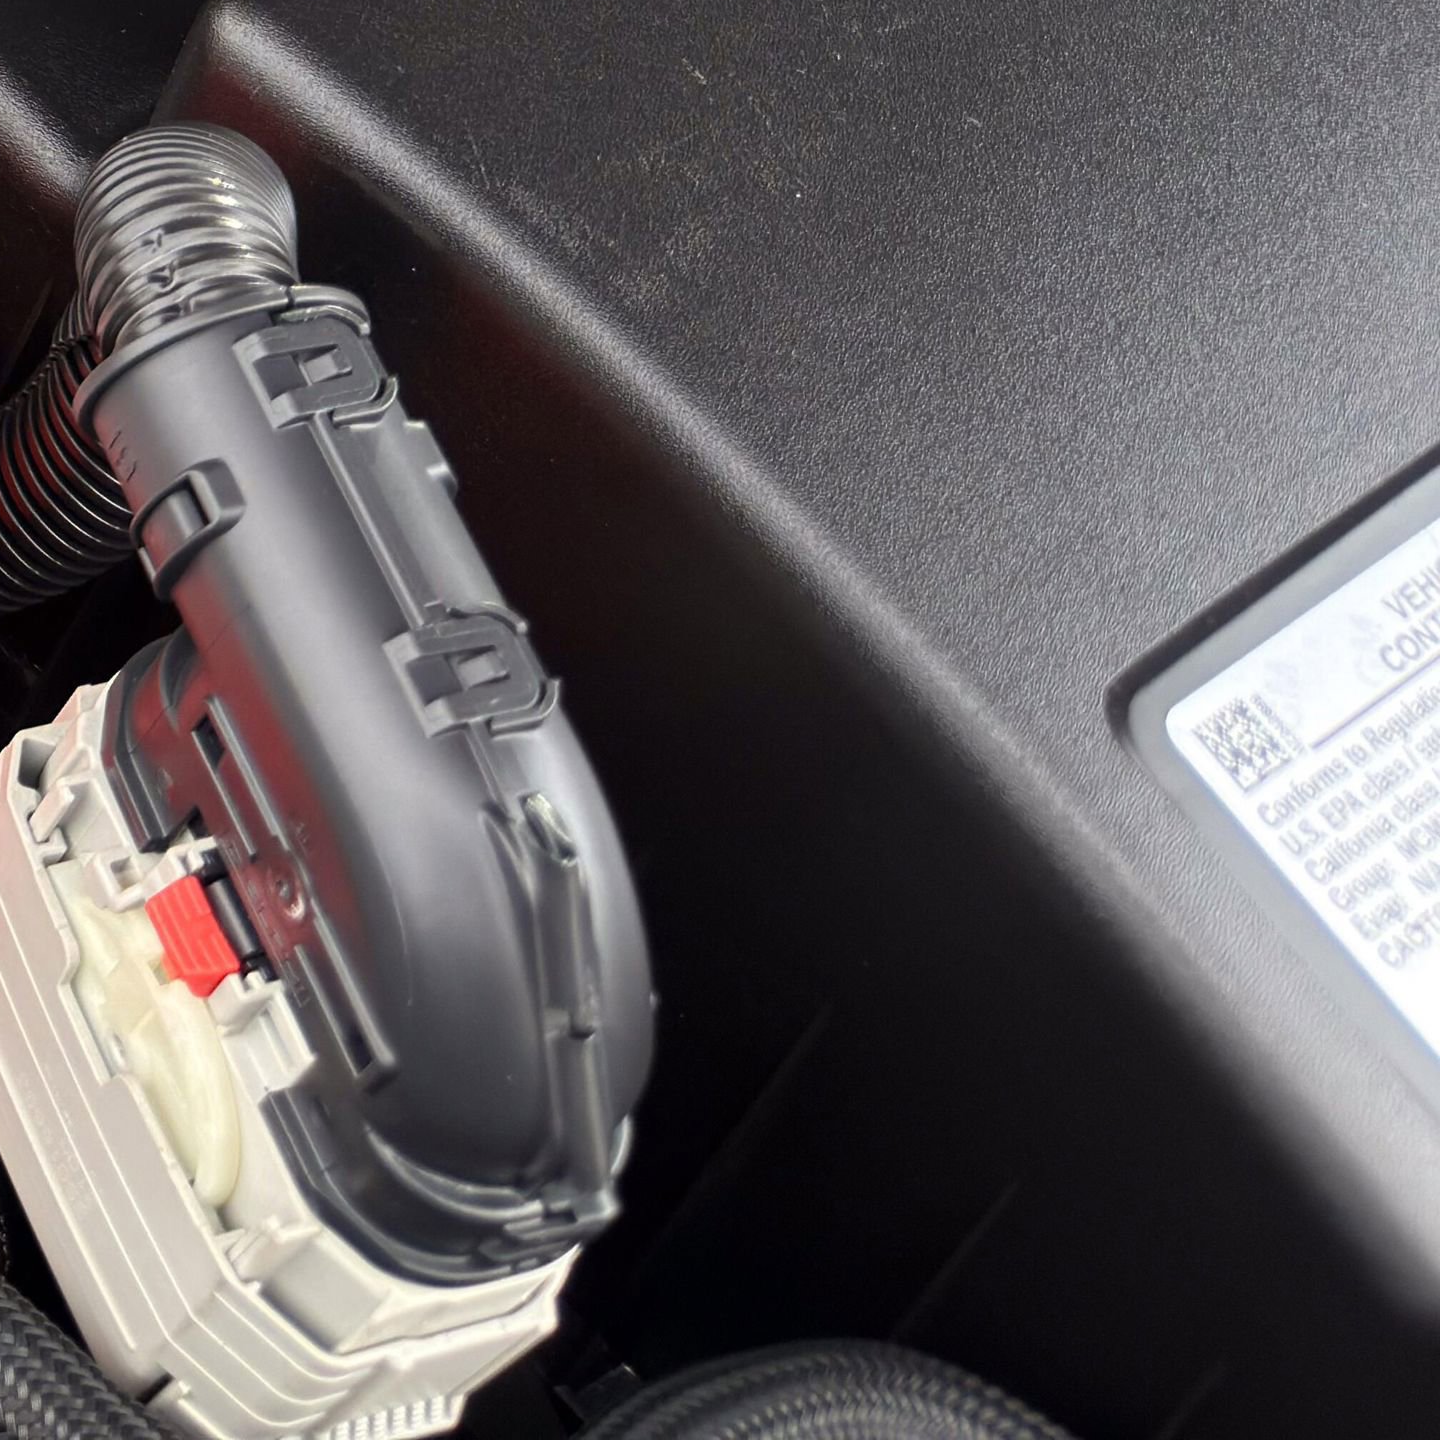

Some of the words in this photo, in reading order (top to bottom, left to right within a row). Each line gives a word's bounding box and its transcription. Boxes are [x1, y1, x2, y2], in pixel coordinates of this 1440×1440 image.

[1381, 560, 1440, 619] VEHI
[1257, 756, 1350, 827] Conforms
[1342, 743, 1371, 768] to
[1318, 788, 1370, 831] EPA
